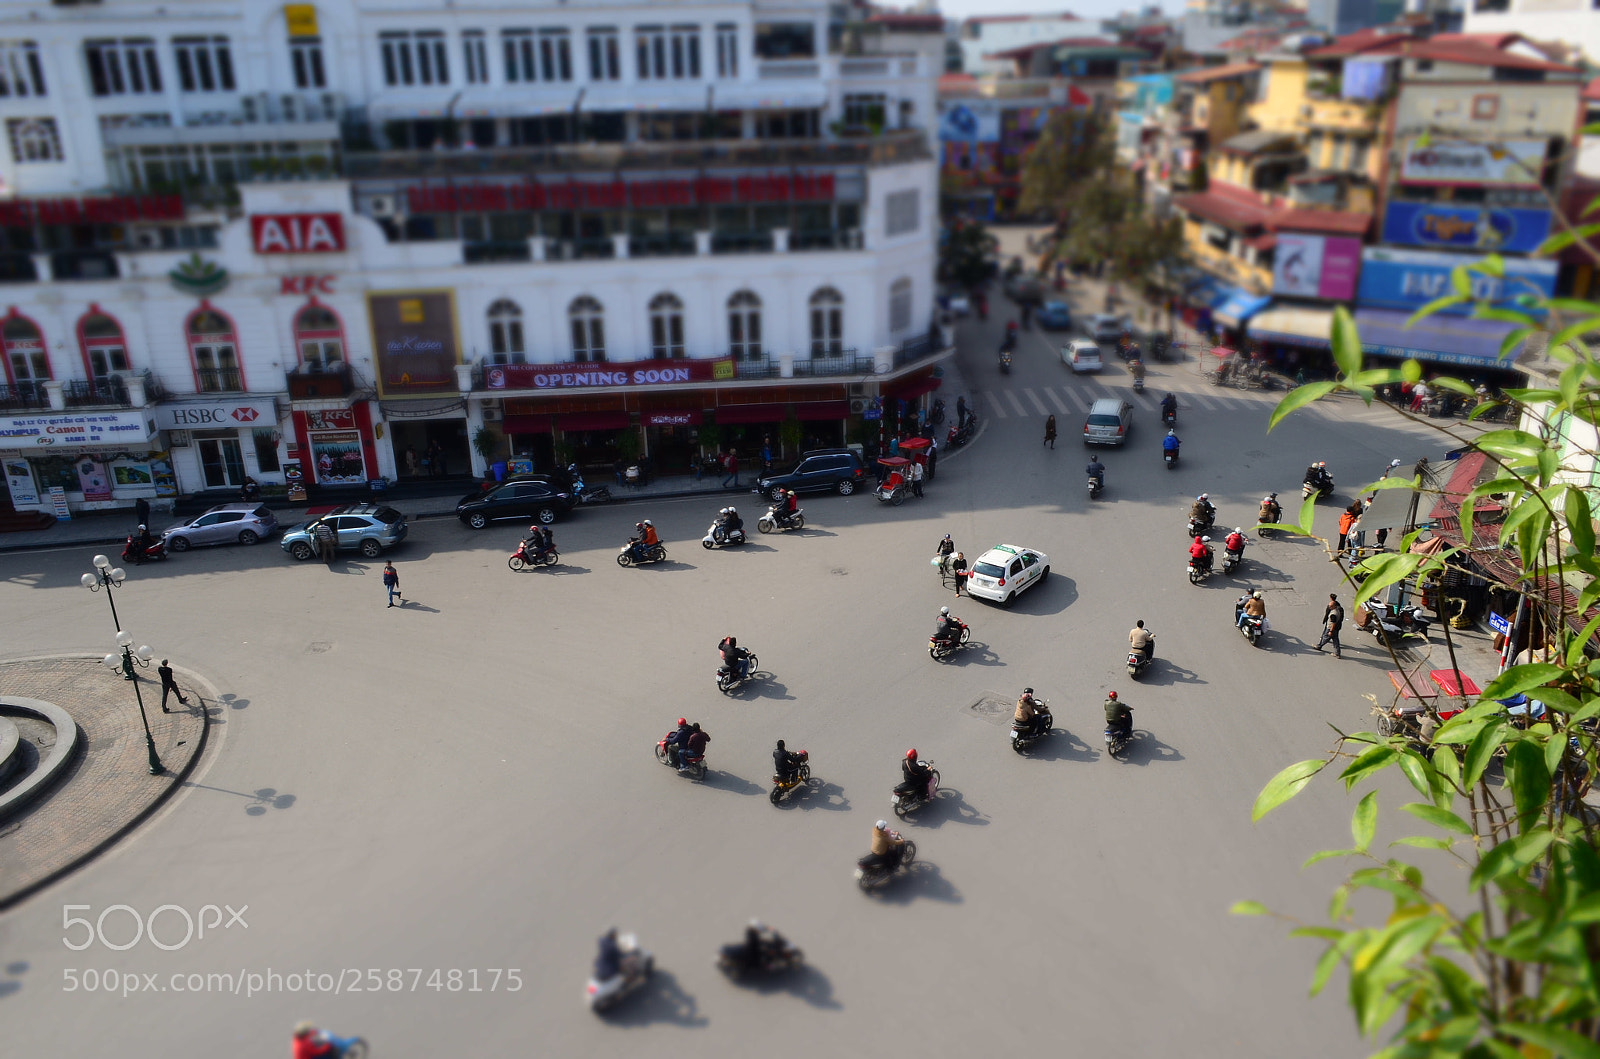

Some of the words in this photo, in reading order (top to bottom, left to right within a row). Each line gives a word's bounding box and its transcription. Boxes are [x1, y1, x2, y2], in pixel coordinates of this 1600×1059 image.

[258, 217, 339, 251] AIA
[280, 274, 336, 296] KFC
[533, 371, 627, 388] OPENING
[634, 367, 689, 384] SOON
[172, 407, 227, 425] HSBC
[324, 410, 352, 420] KFC
[0, 428, 40, 436] LYMPUS
[46, 426, 85, 434] Canon
